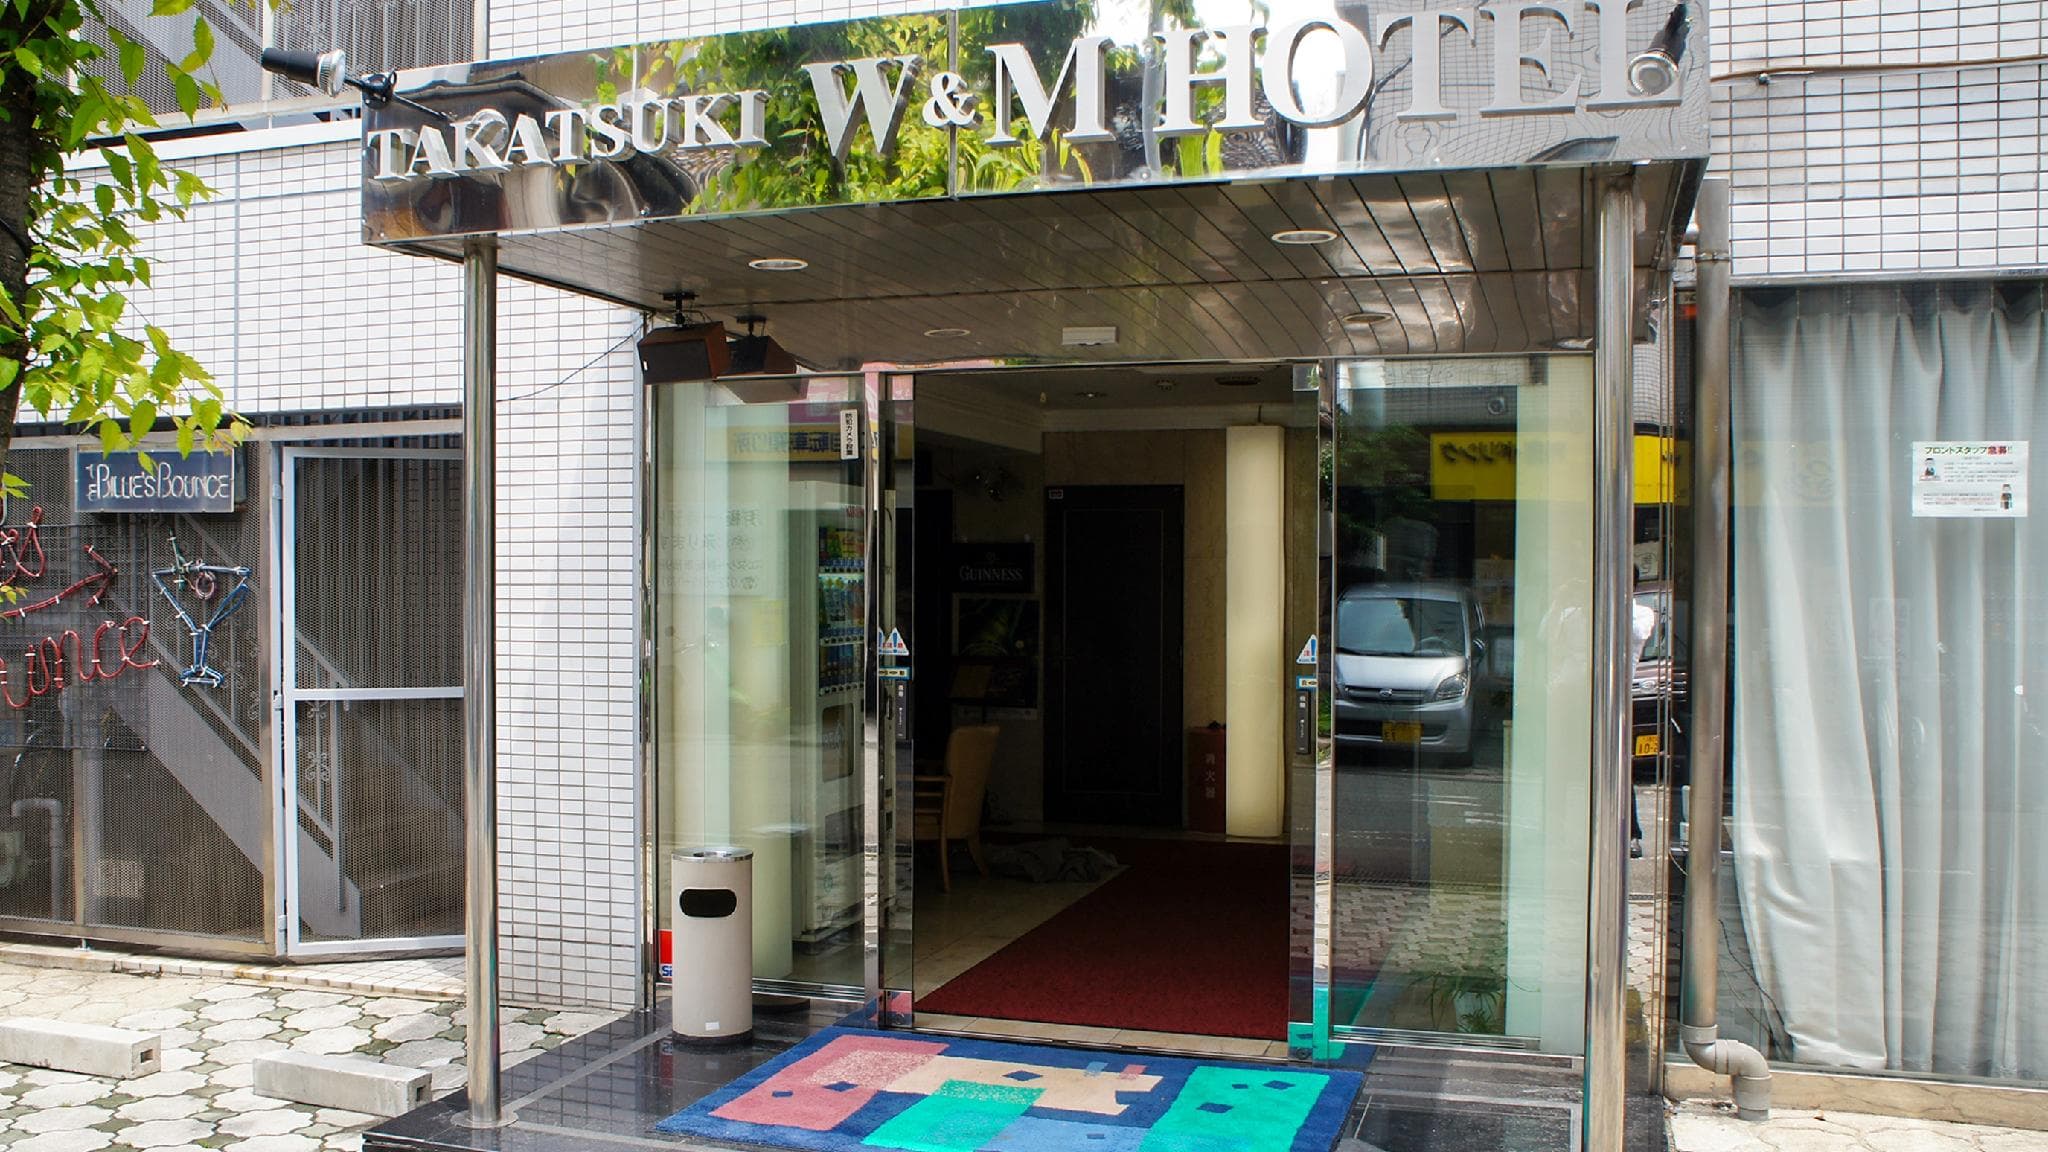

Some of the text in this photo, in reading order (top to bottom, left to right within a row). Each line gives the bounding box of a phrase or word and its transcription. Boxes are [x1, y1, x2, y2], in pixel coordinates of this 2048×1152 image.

[367, 90, 771, 180] TAKATSUKI
[1153, 0, 1682, 134] HOTEL
[959, 565, 1024, 581] GUINNESS
